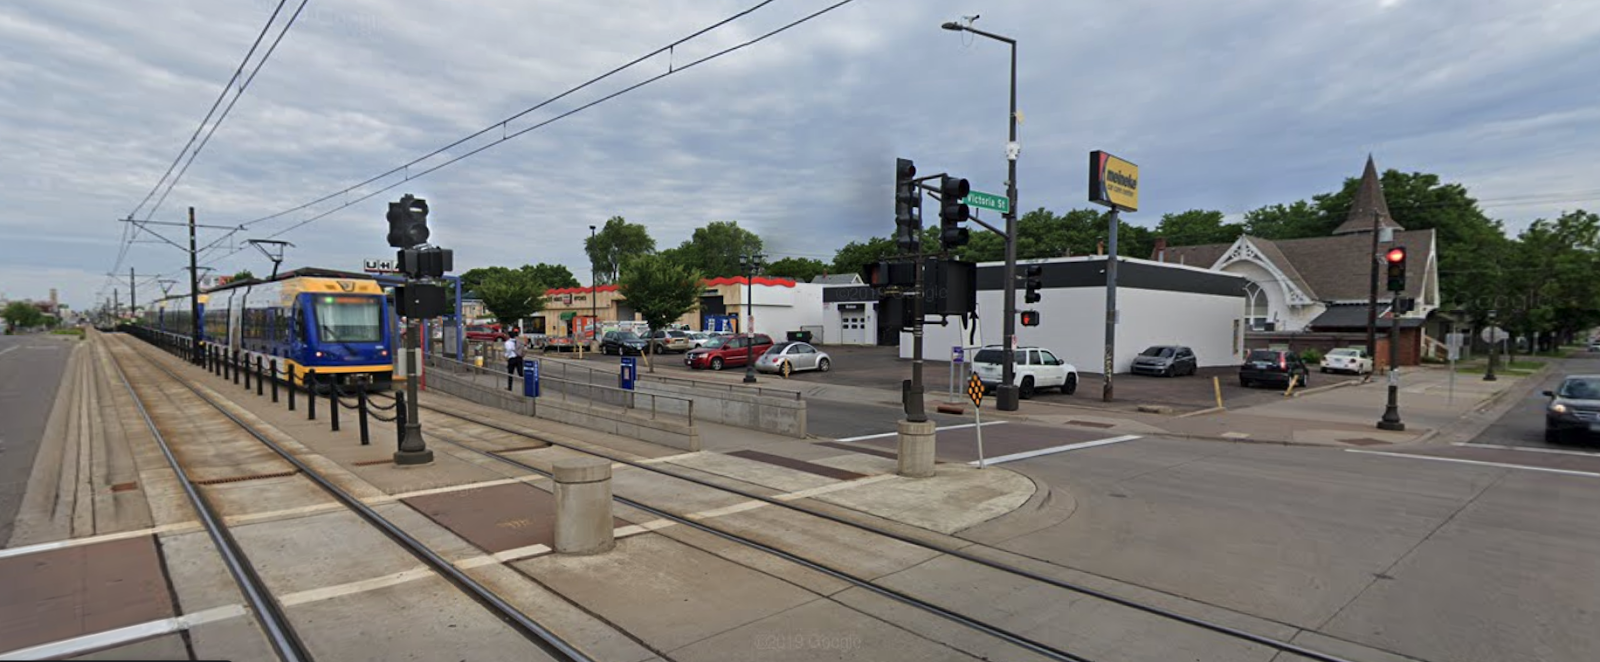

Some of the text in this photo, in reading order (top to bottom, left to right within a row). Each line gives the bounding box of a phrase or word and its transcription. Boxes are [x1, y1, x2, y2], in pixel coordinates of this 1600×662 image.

[1107, 169, 1137, 190] meineke
[967, 193, 1006, 209] Victoria St
